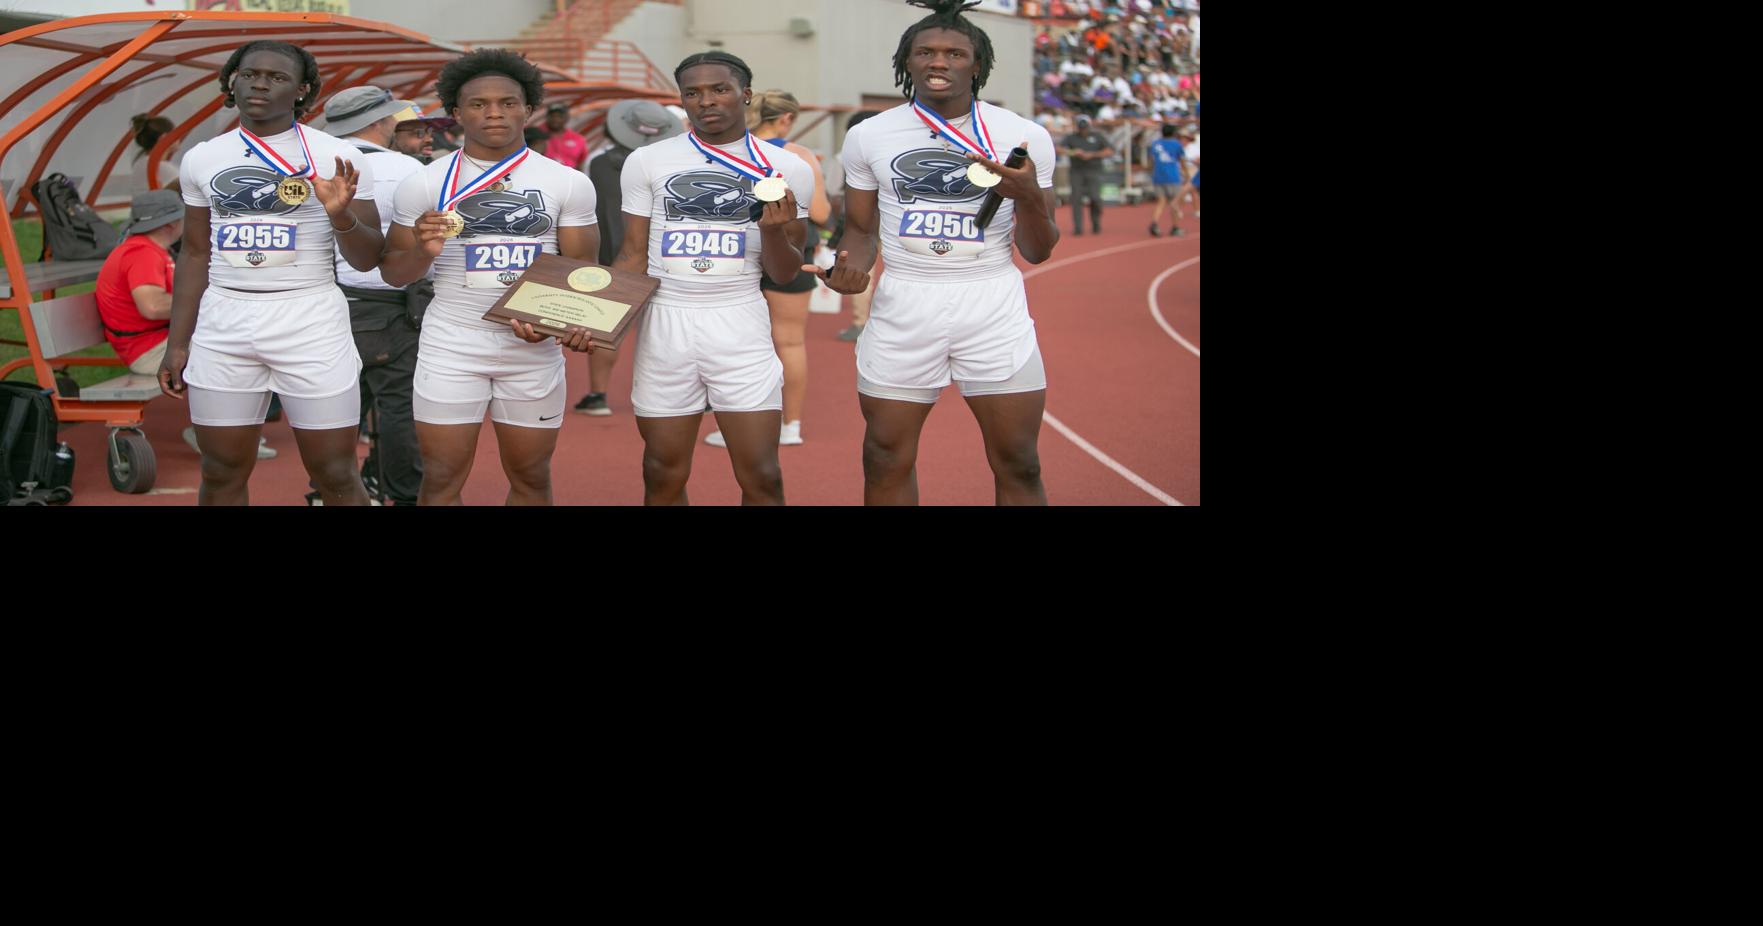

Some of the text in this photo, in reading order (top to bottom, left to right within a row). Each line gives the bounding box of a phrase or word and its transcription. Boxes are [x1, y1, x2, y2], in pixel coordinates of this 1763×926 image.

[222, 225, 290, 248] 2955
[905, 212, 979, 239] 2950
[667, 231, 739, 256] 2946
[475, 245, 536, 269] 2947
